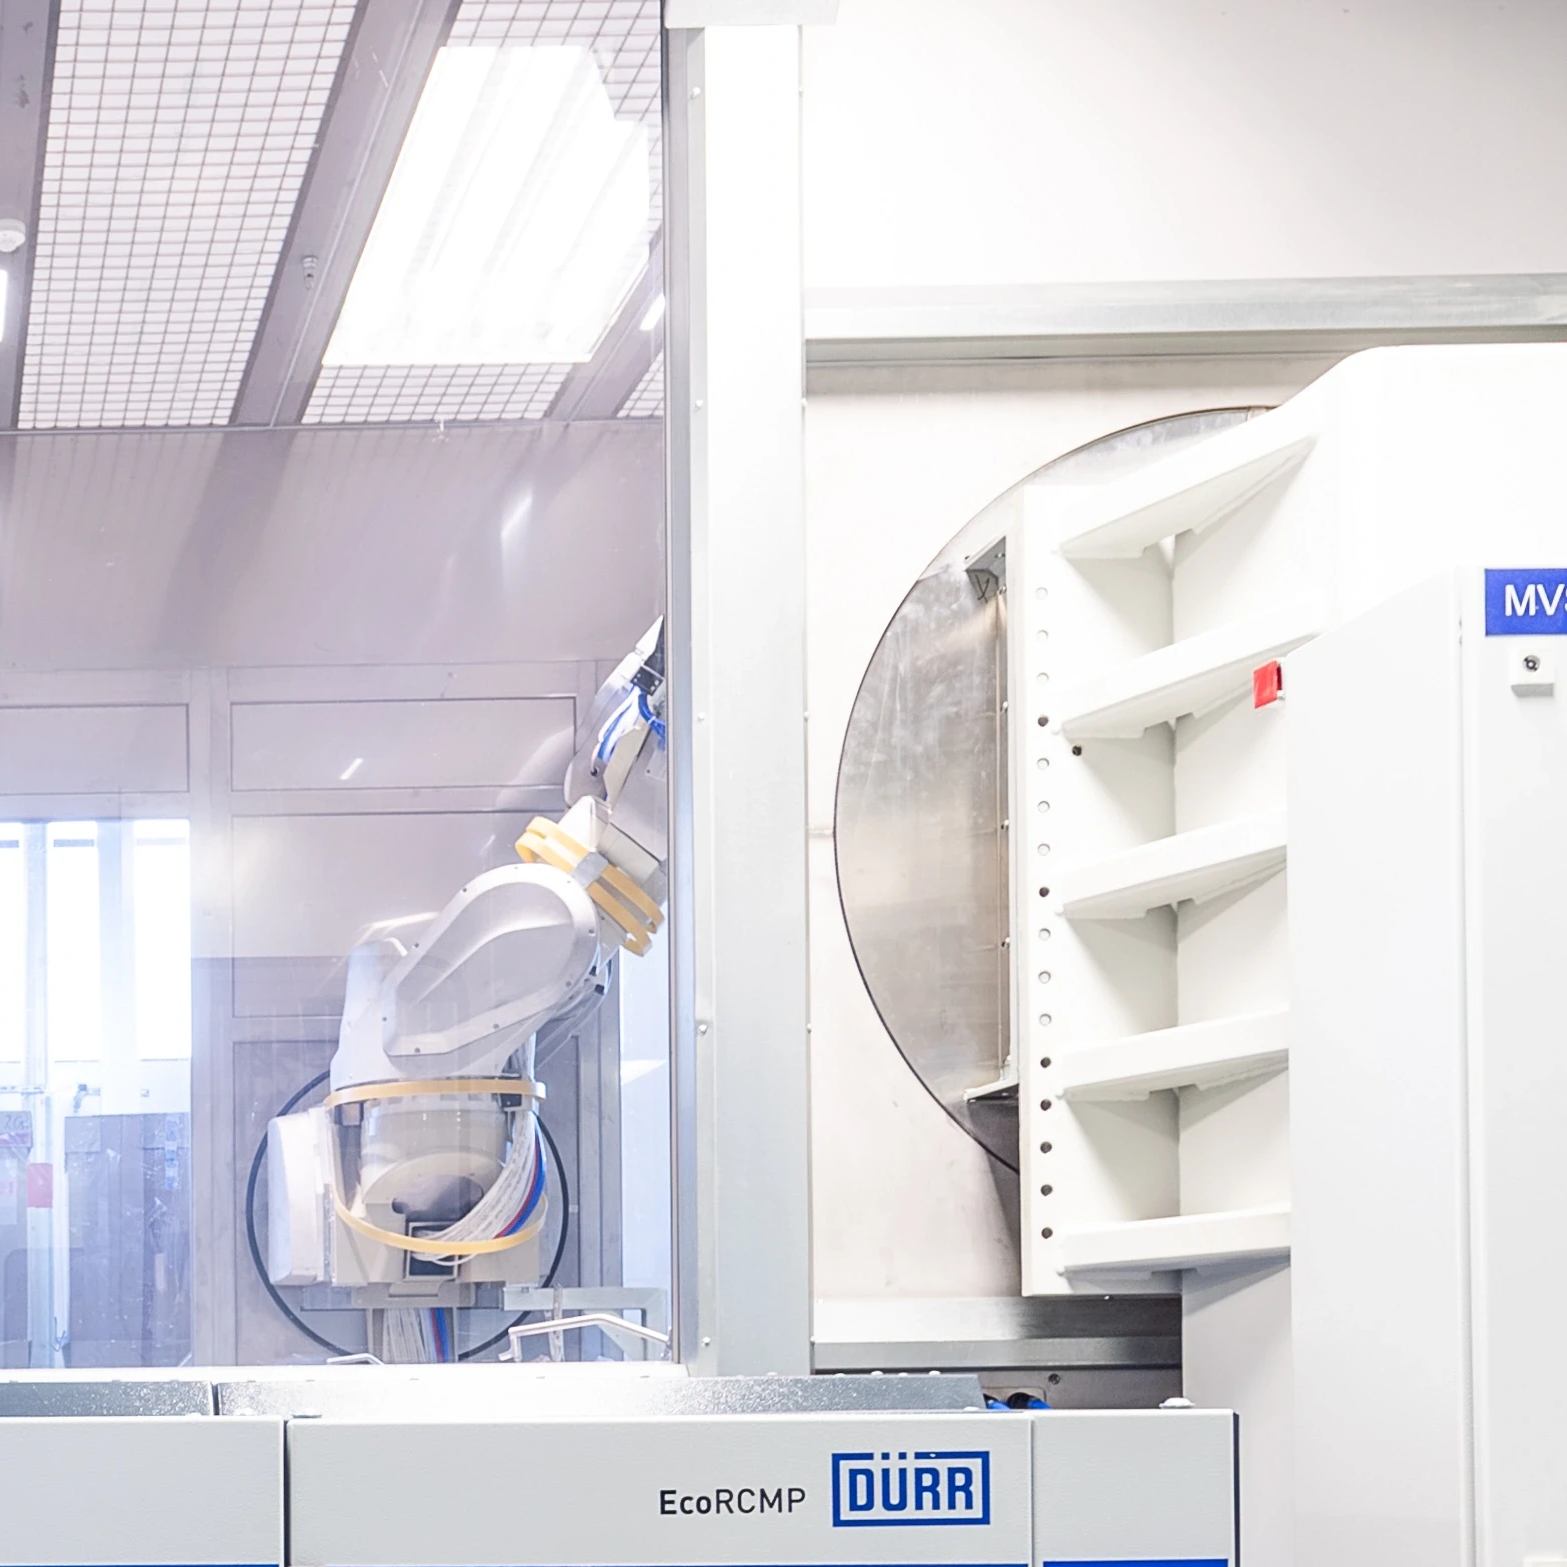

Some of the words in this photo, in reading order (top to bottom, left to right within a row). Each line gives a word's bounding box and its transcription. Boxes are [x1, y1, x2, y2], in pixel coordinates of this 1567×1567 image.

[1505, 583, 1567, 617] MV
[848, 1451, 975, 1512] DÜRR
[660, 1487, 806, 1515] EcoRCMP
